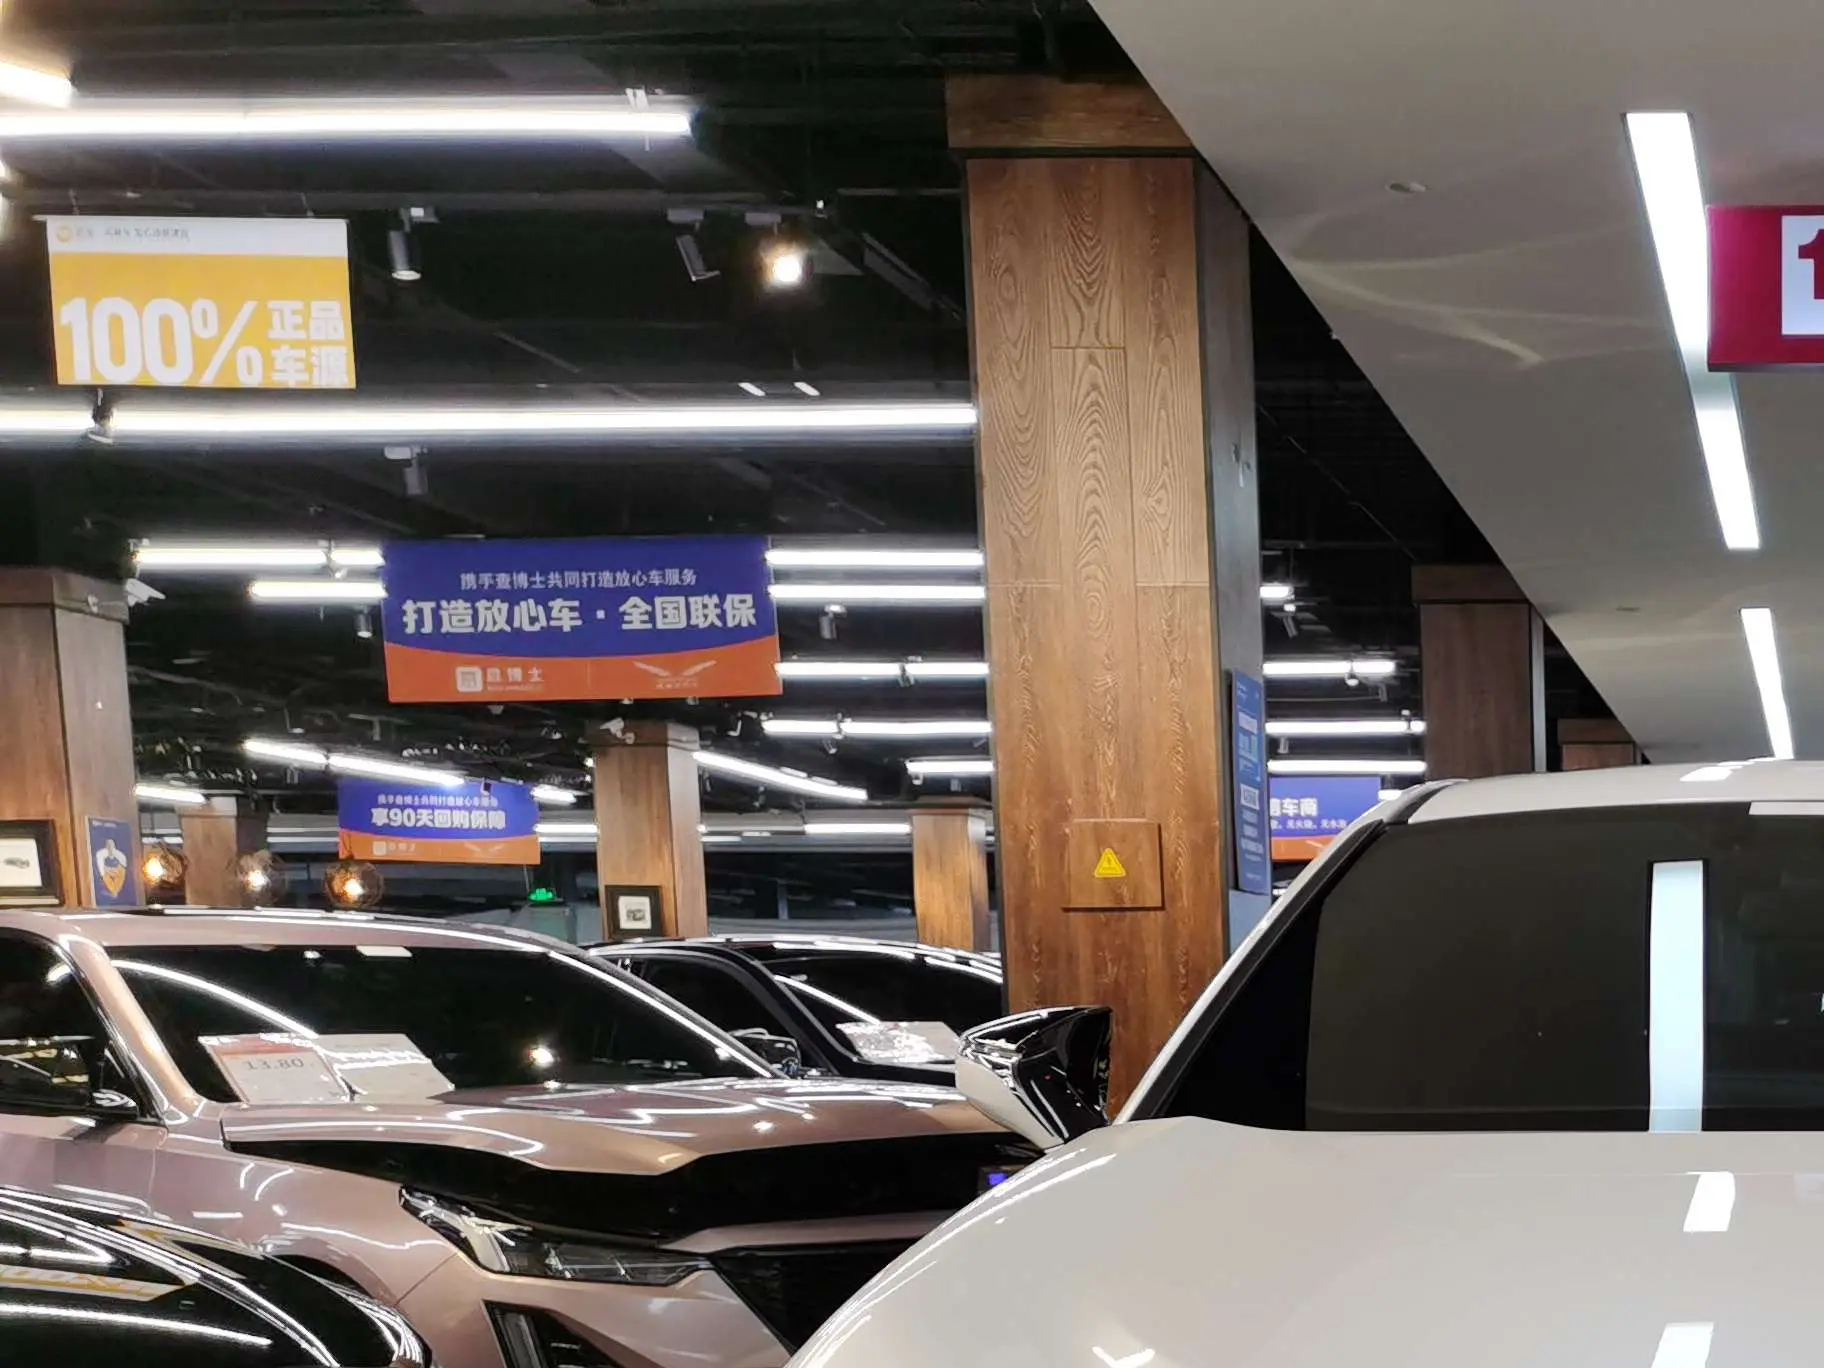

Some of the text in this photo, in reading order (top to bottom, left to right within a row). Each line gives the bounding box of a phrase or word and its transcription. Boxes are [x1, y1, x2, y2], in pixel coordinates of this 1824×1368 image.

[60, 296, 263, 387] 100%
[267, 299, 346, 342] 正品
[271, 344, 349, 388] 车源
[371, 807, 506, 830] 享90天回购保障
